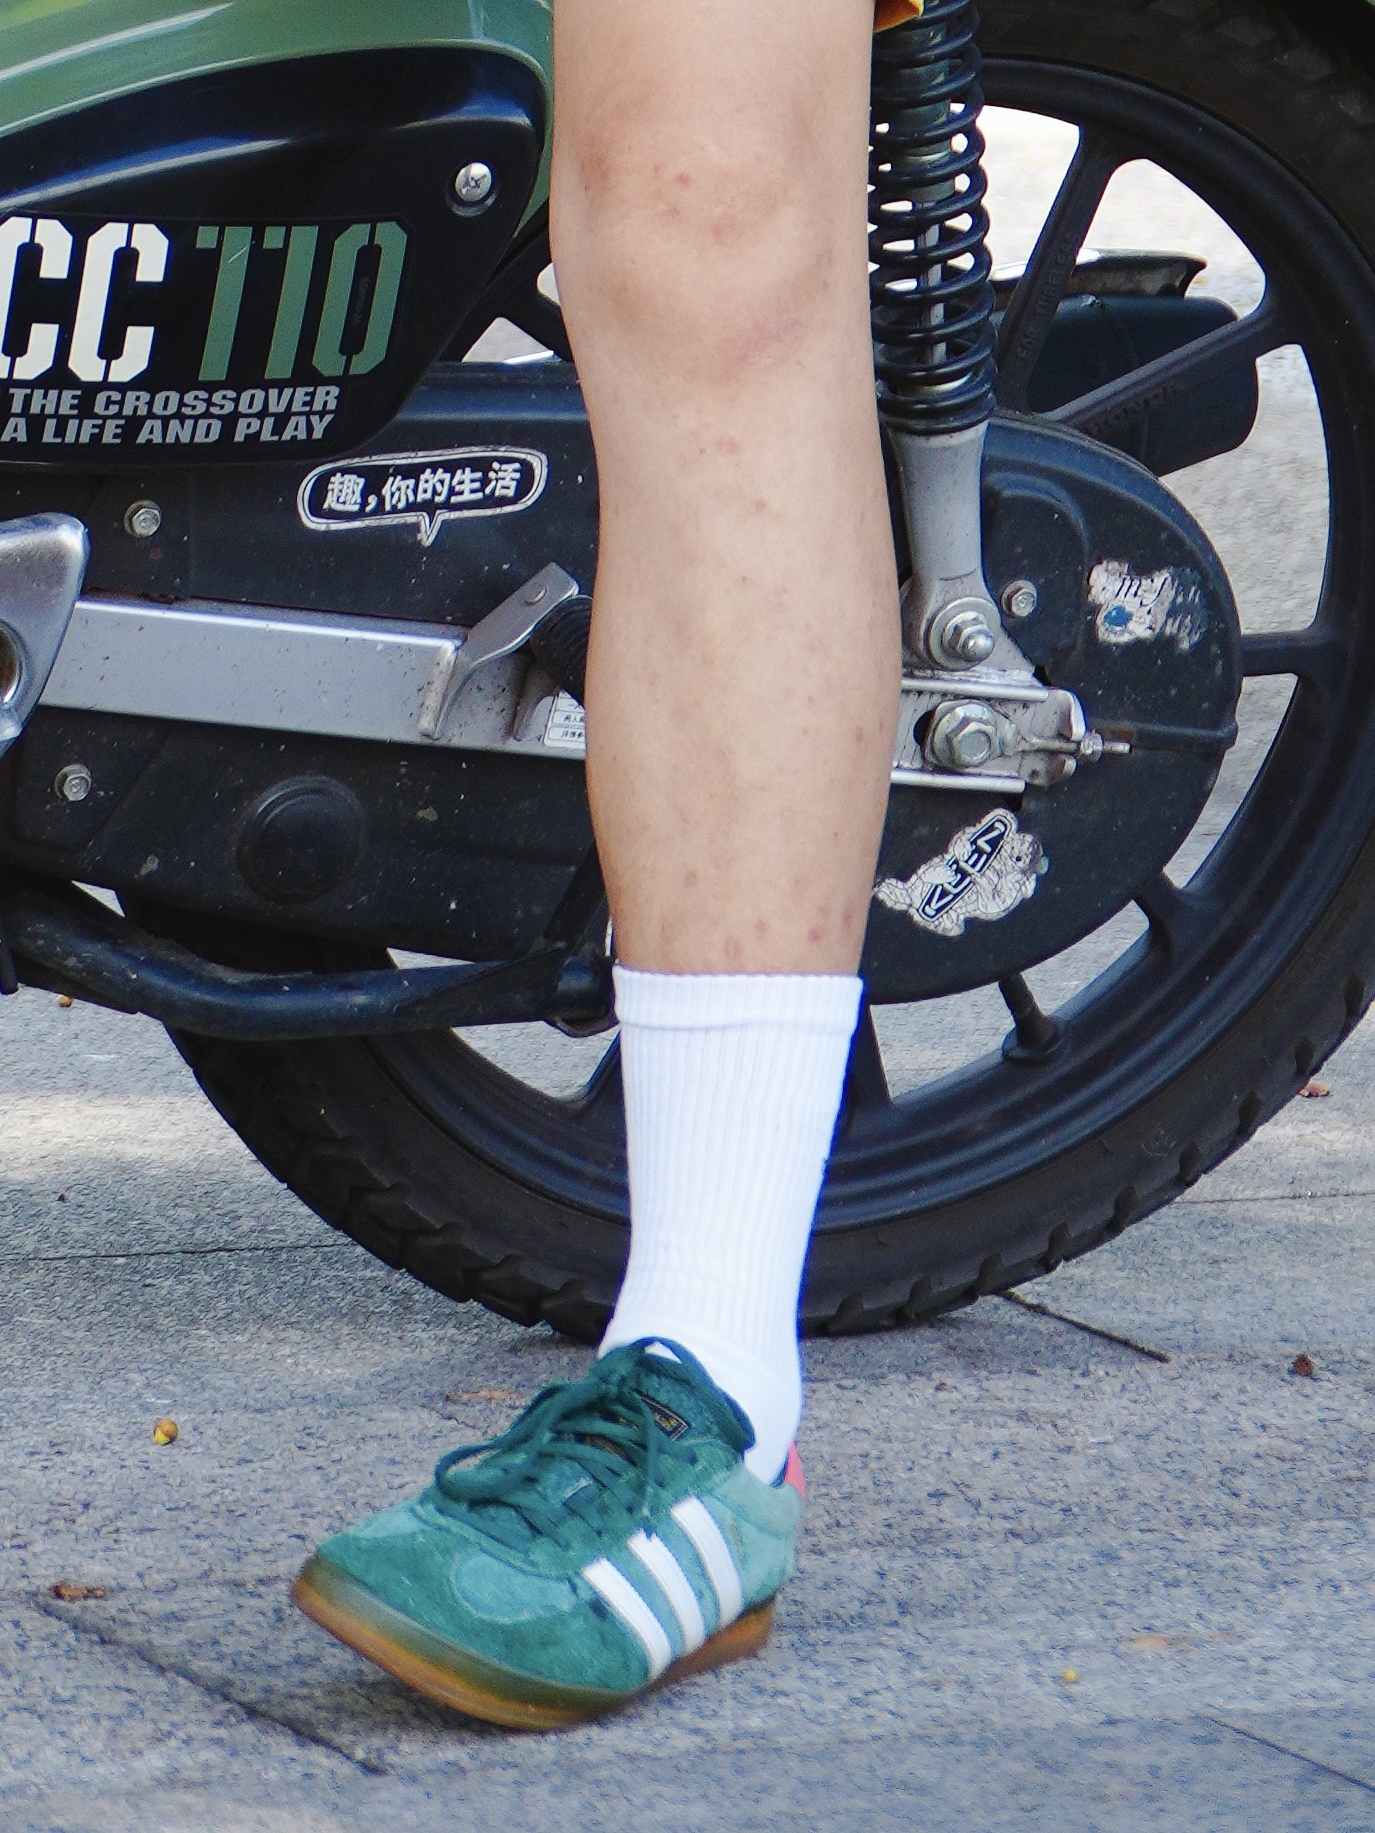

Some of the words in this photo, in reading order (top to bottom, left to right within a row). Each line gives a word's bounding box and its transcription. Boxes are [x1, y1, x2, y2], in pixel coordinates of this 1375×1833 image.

[8, 387, 80, 415] THE
[93, 386, 340, 416] CROSSOVER
[0, 417, 28, 443] A
[41, 418, 126, 444] LIFE
[135, 418, 223, 444] AND
[233, 414, 336, 444] PLAY
